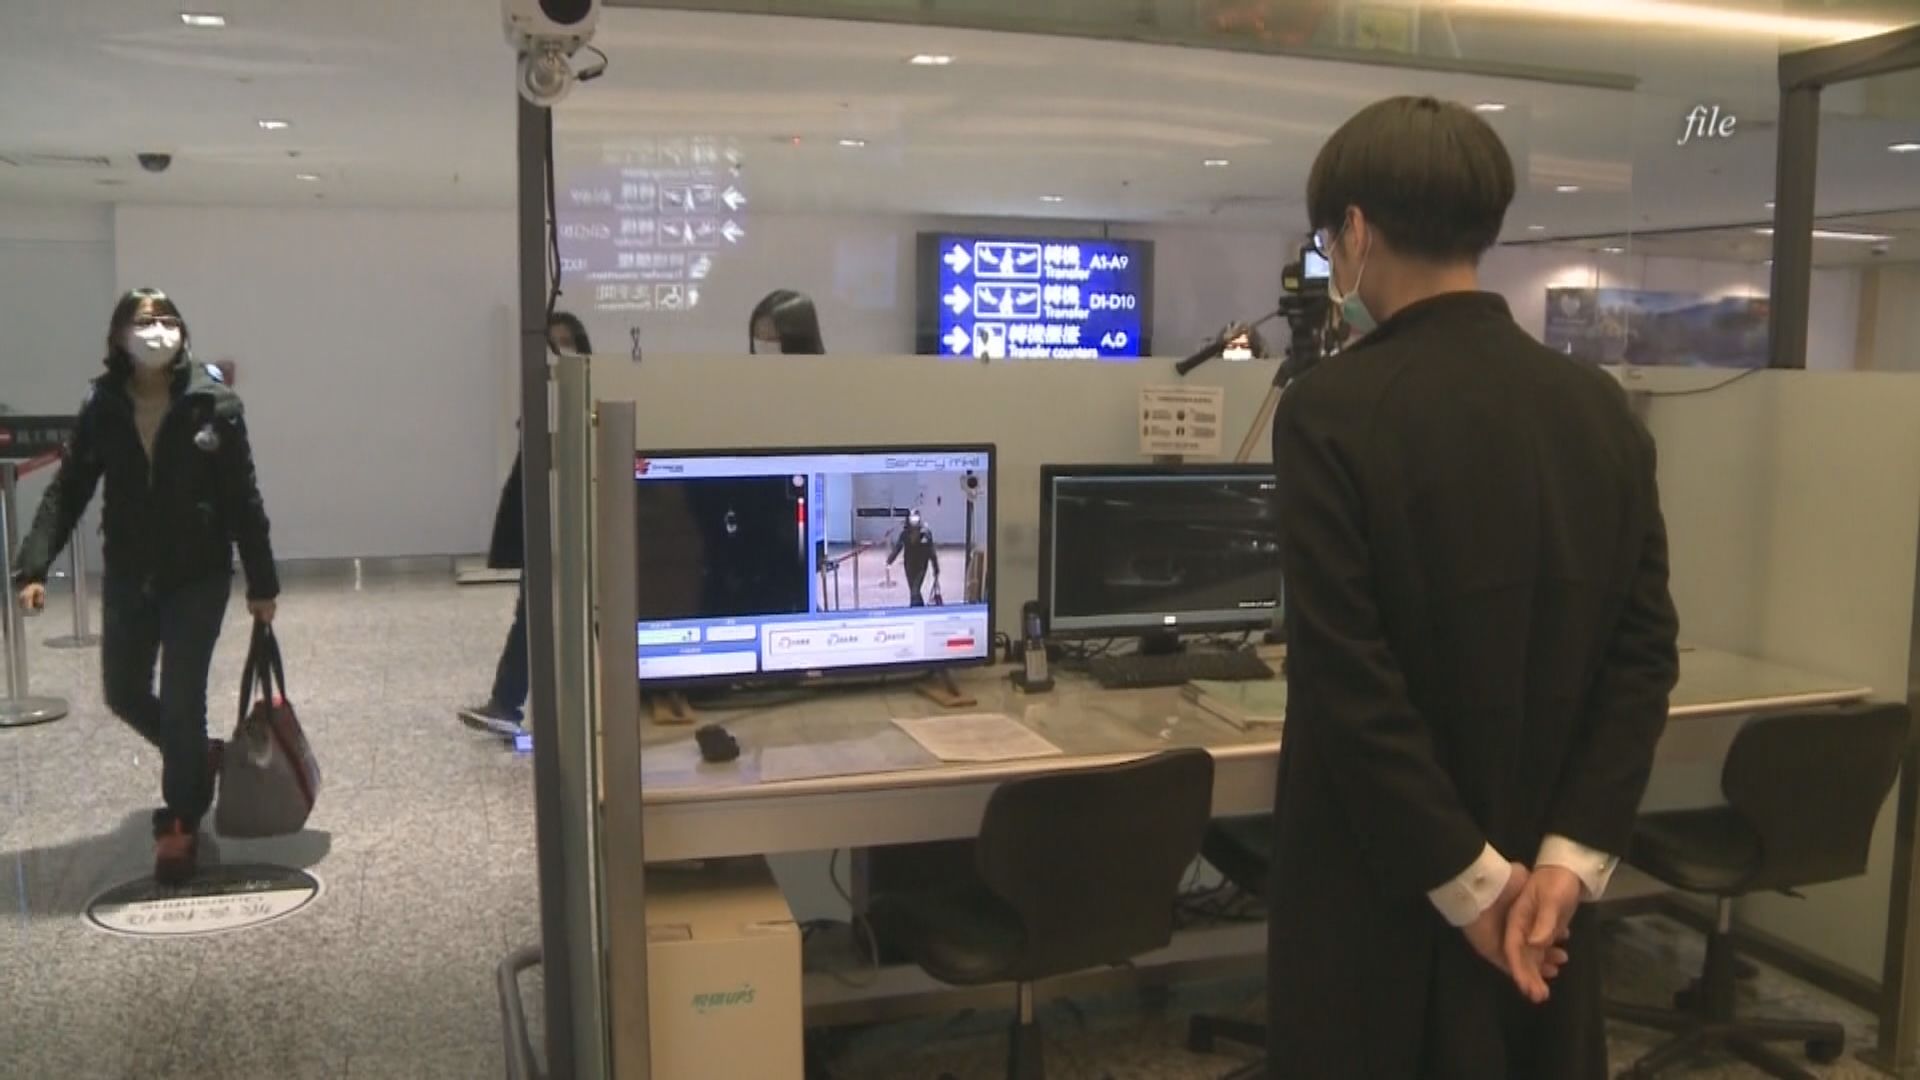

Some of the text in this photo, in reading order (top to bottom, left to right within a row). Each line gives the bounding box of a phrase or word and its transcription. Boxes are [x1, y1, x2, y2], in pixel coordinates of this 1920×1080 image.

[1089, 254, 1129, 271] A1-A9
[1044, 265, 1091, 282] Transfer
[1090, 294, 1136, 310] D1-D10
[1044, 305, 1090, 320] Transfer
